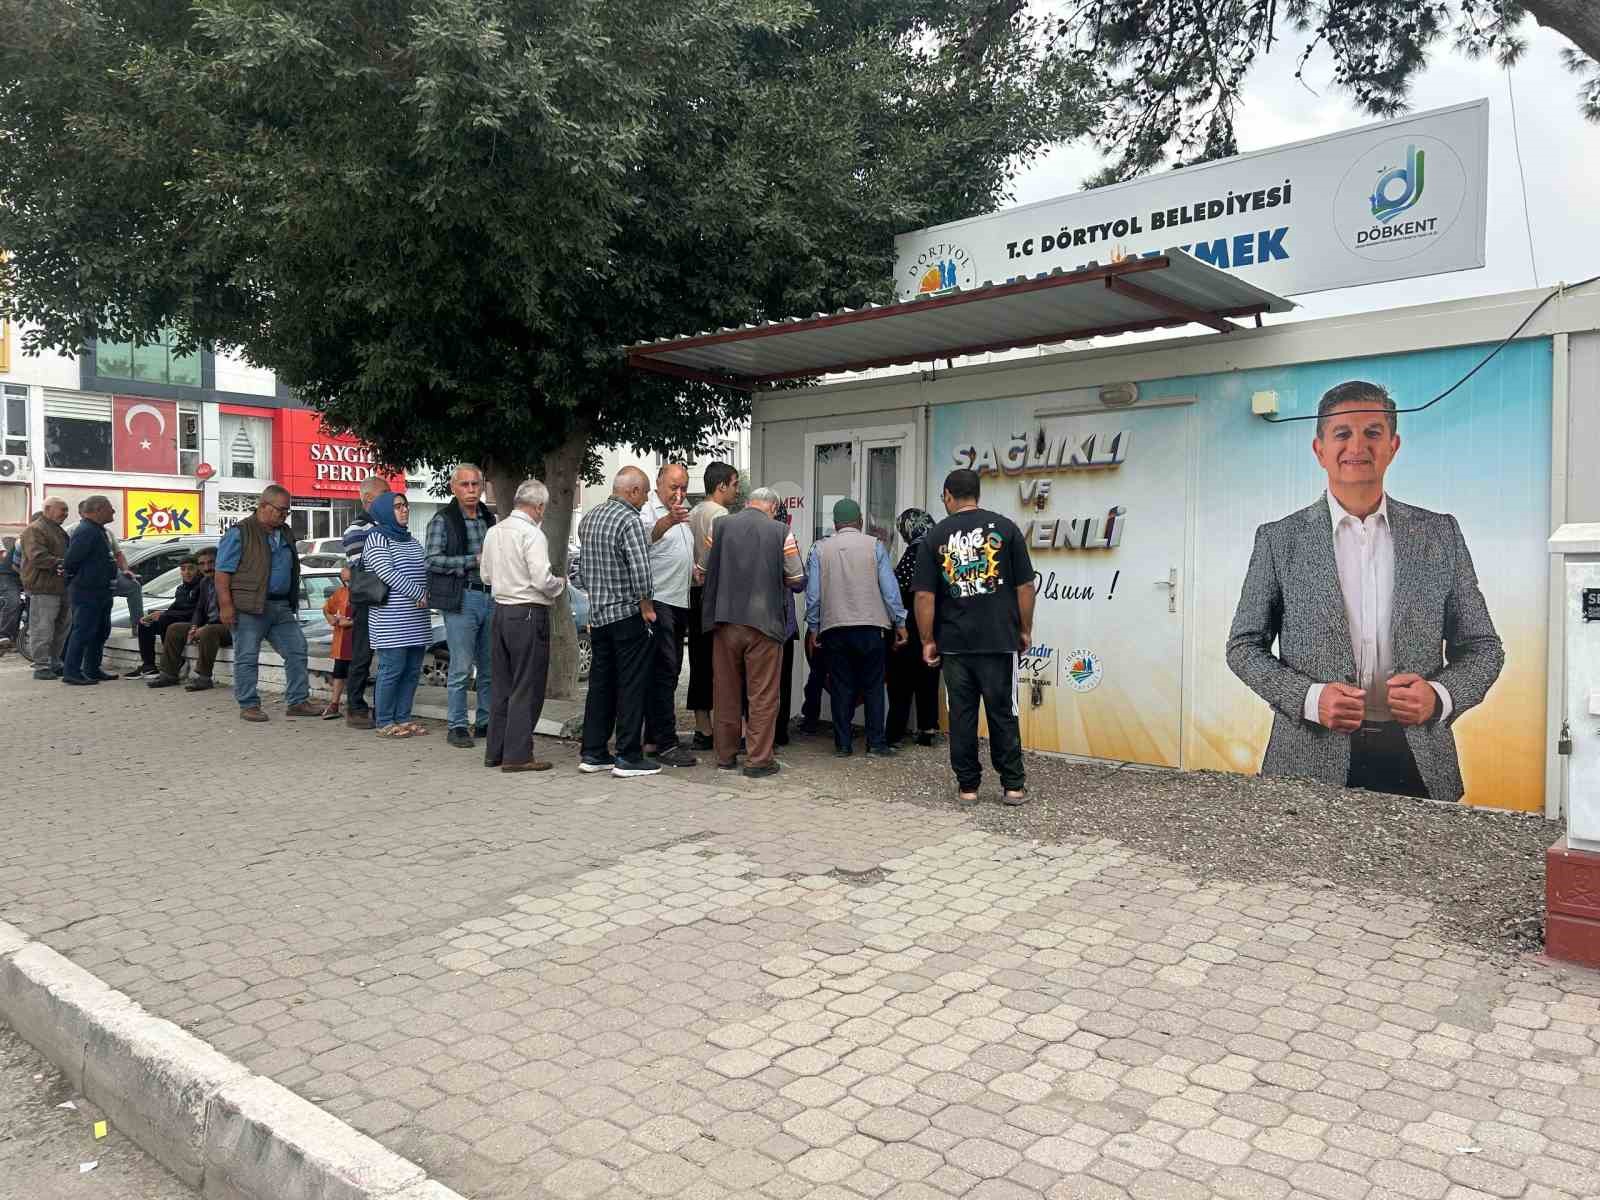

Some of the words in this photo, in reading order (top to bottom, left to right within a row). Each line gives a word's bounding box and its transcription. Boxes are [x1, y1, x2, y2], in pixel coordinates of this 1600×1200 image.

[1006, 239, 1034, 259] T.C
[1041, 216, 1142, 253] DÖRTYOL
[1151, 179, 1292, 230] BELEDİYESİ
[1357, 217, 1438, 244] DÖBKENT
[951, 431, 1132, 475] SAĞLIKLI
[134, 507, 192, 535] ŞOK
